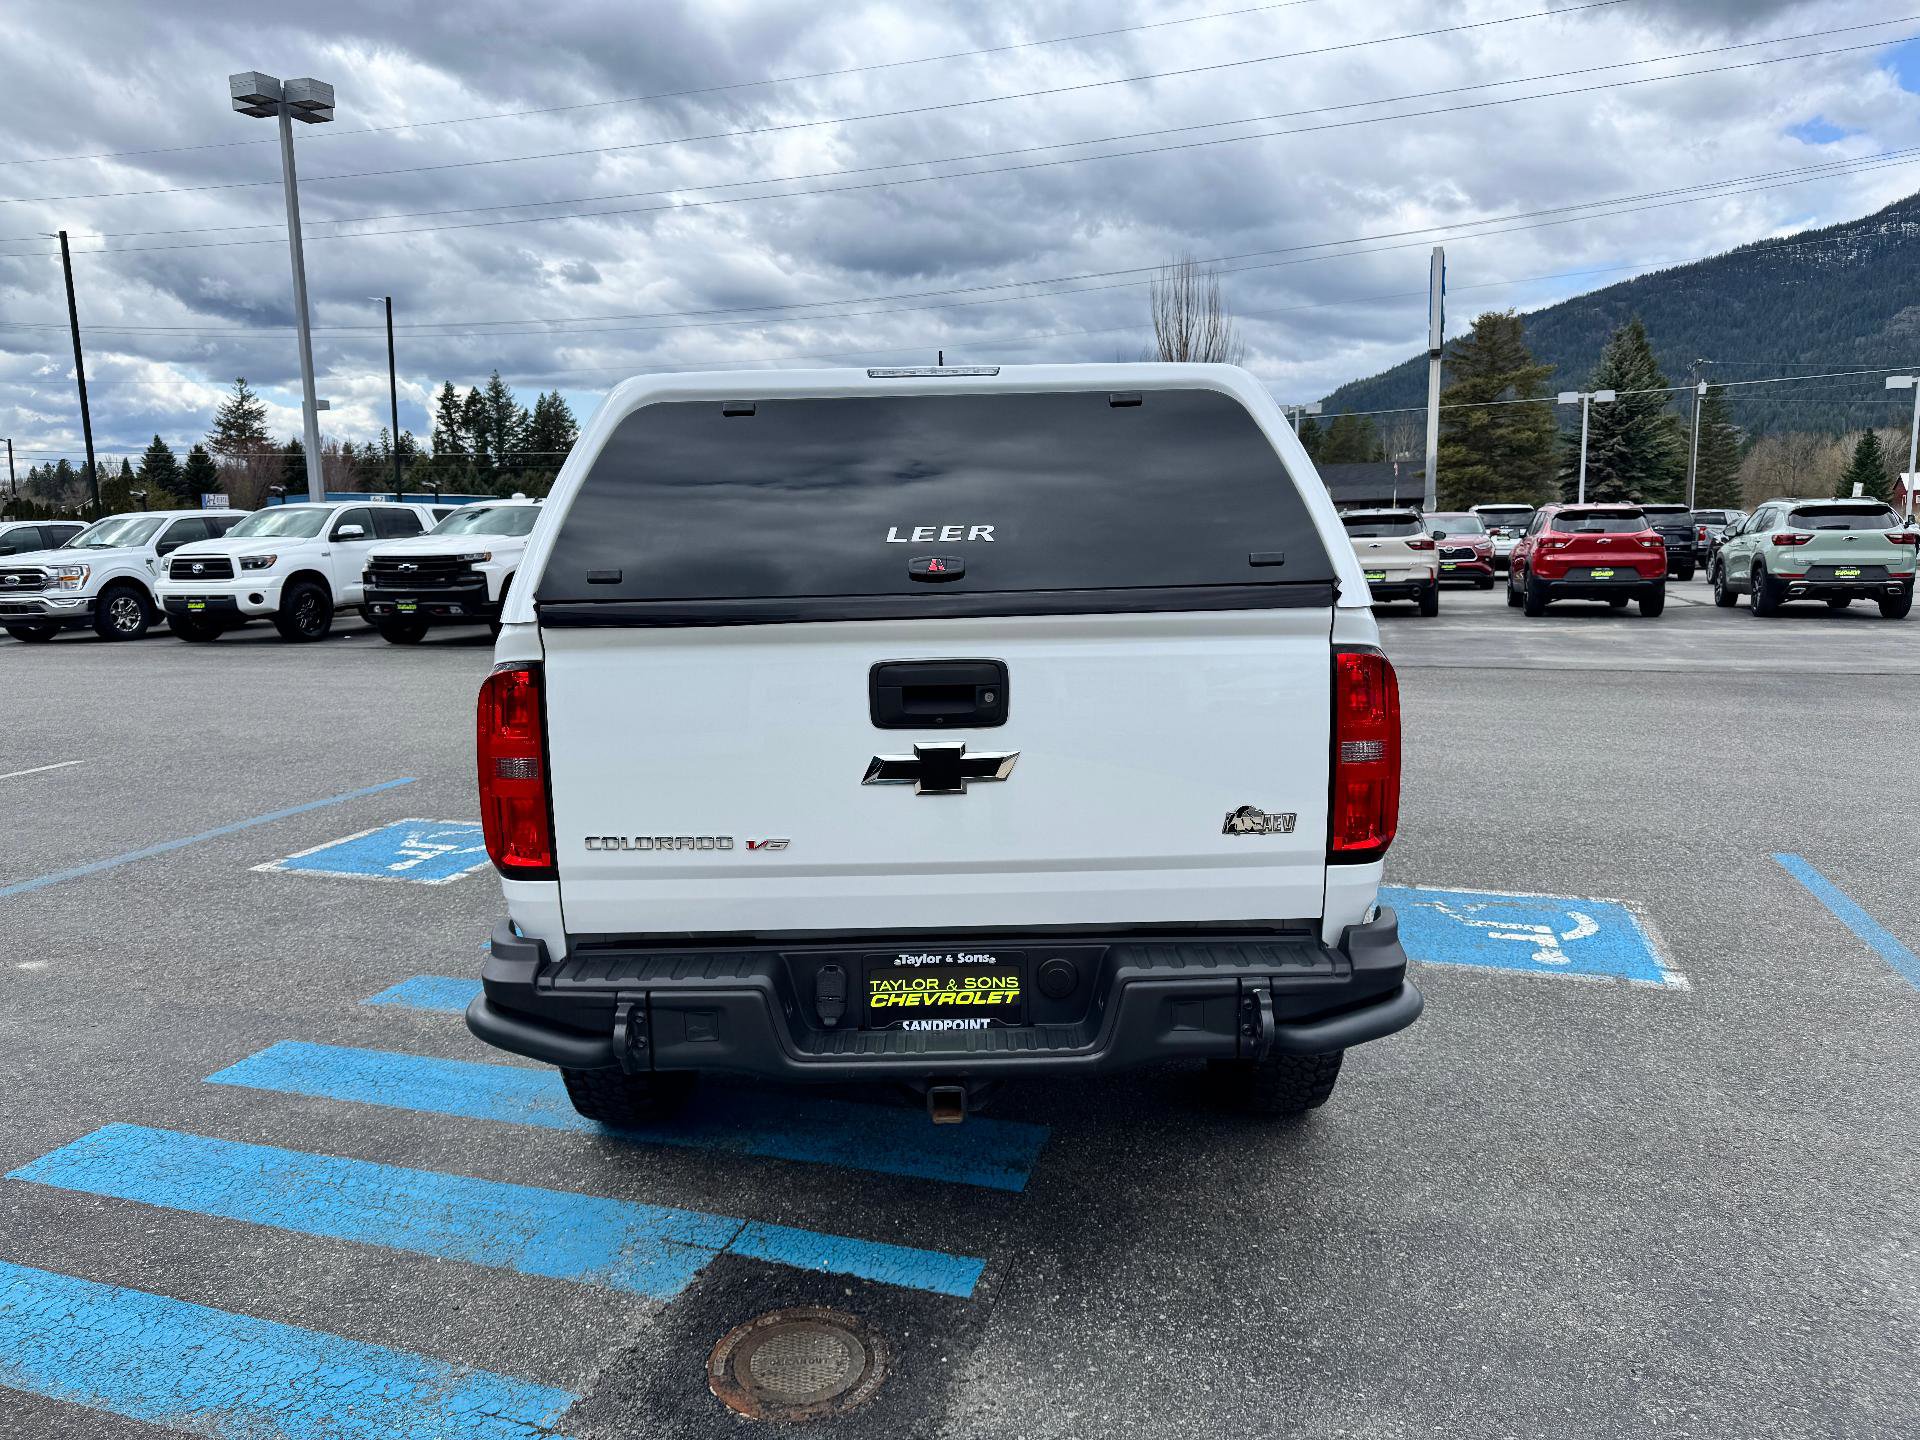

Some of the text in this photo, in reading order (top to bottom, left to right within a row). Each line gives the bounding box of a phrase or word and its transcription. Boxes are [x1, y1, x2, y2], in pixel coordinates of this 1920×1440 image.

[886, 525, 995, 543] LEER
[585, 836, 791, 850] COLORADO V6
[899, 952, 989, 967] Taylor & Sons
[870, 976, 1019, 991] TAYLOR & SONS
[870, 990, 1019, 1008] CHEVROLET
[902, 1018, 991, 1031] SANDPOINT
